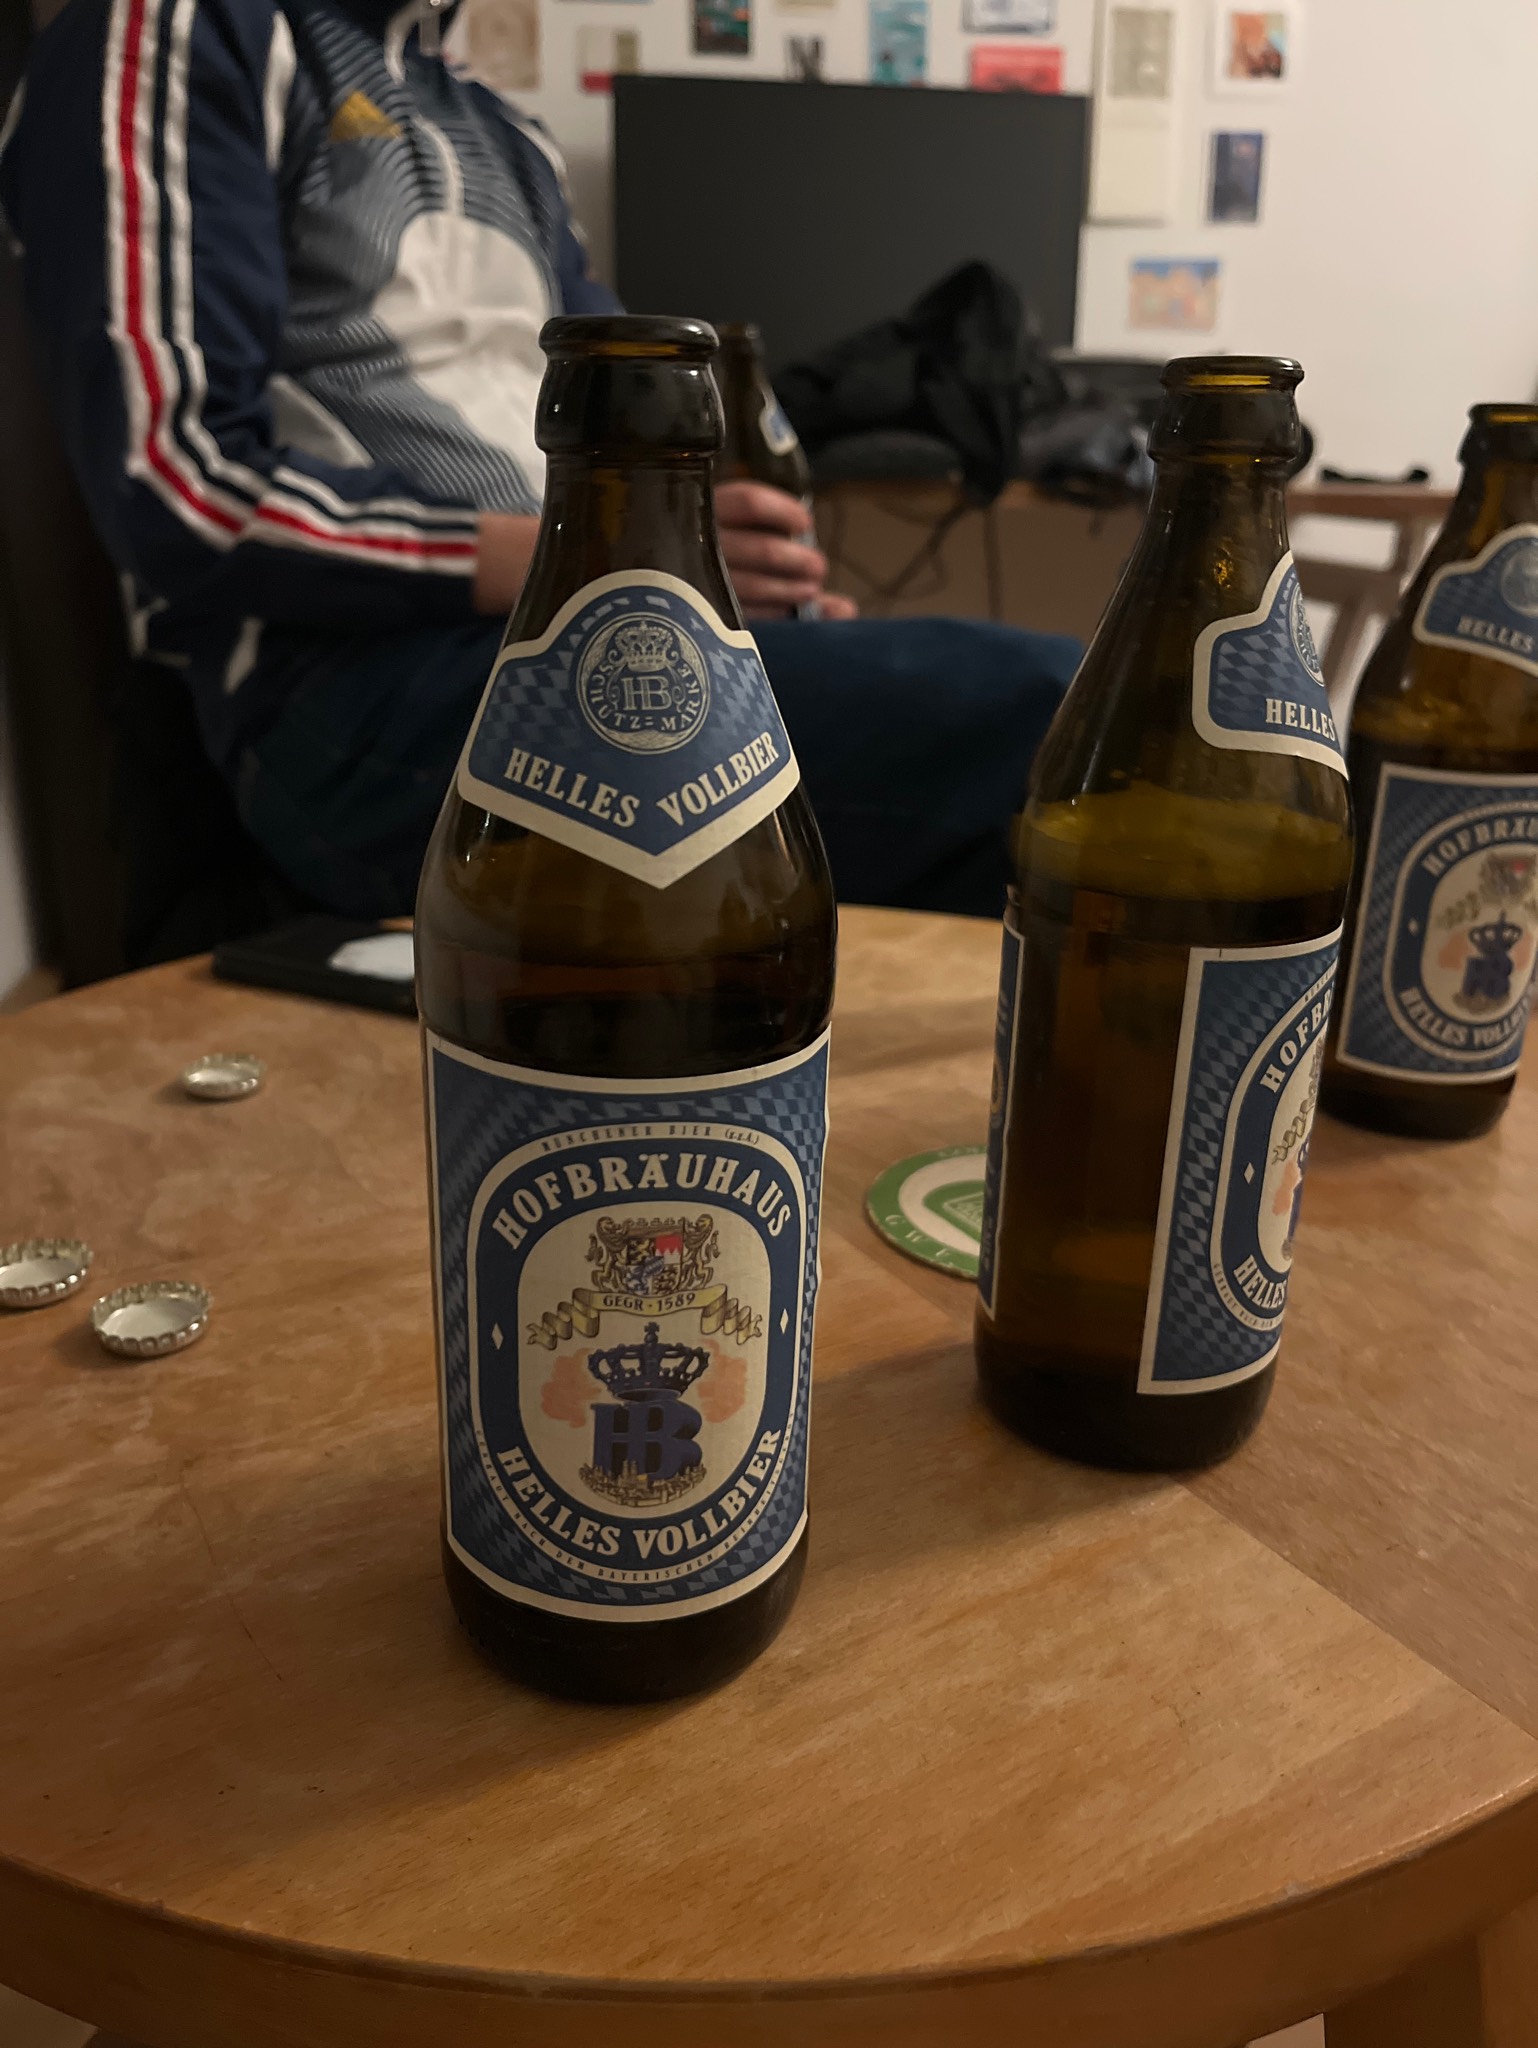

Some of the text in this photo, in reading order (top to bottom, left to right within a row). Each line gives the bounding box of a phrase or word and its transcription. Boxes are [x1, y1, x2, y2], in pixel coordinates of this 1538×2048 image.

[620, 676, 672, 711] HB
[1266, 698, 1336, 741] HELLES
[503, 731, 780, 829] HELLES VOLLBIER
[1260, 986, 1334, 1094] HOFBR
[669, 1125, 712, 1136] BIER
[491, 1152, 793, 1251] HOFBRÄUHAUS
[657, 1293, 697, 1312] 1589
[590, 1401, 704, 1485] HB
[496, 1428, 783, 1559] HELLES VOLLBIER
[513, 1511, 546, 1547] NACH
[555, 1551, 586, 1571] DEM
[598, 1553, 714, 1581] BAYERISCHEN
